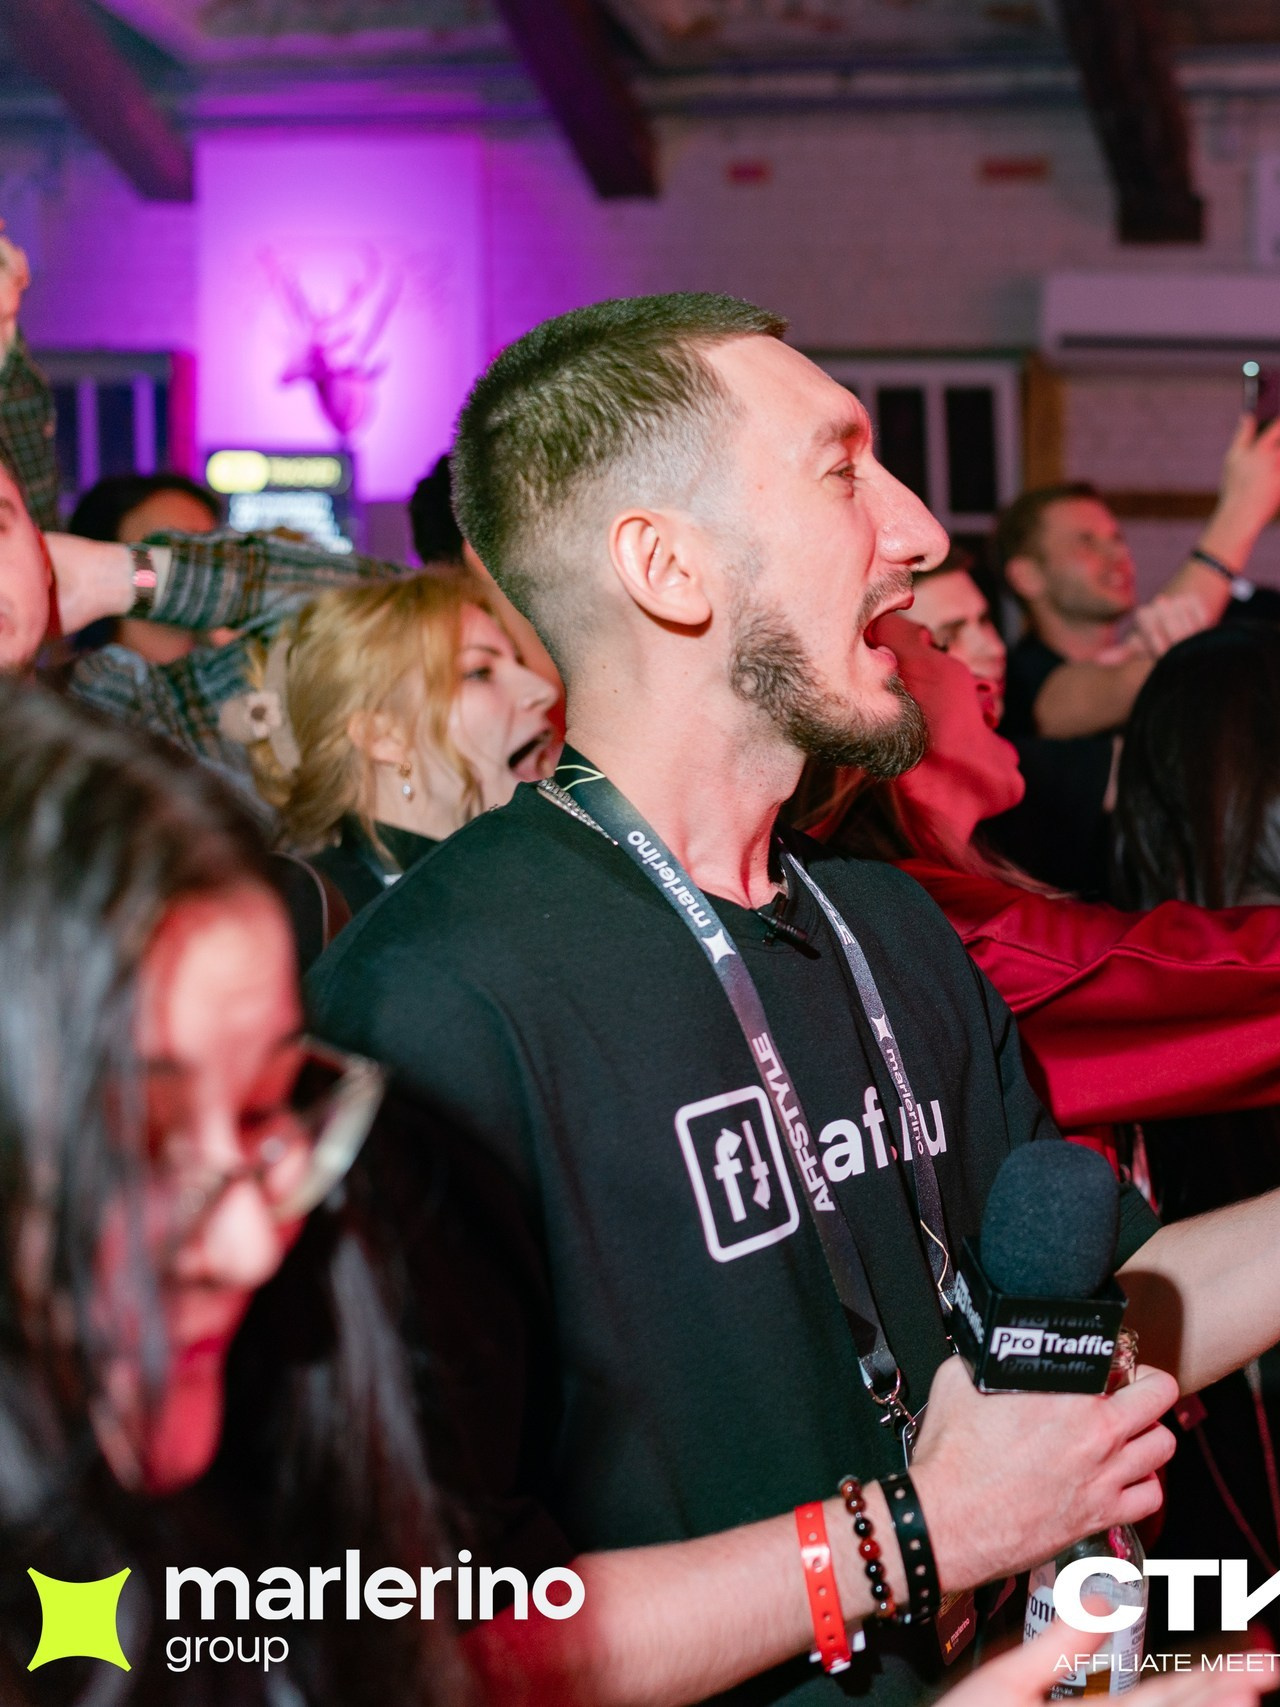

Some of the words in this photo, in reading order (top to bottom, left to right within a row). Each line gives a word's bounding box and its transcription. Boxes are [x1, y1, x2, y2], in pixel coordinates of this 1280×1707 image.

[627, 830, 712, 928] marlerino
[752, 1032, 835, 1211] AFFSTYLE
[886, 1048, 924, 1155] marlerino
